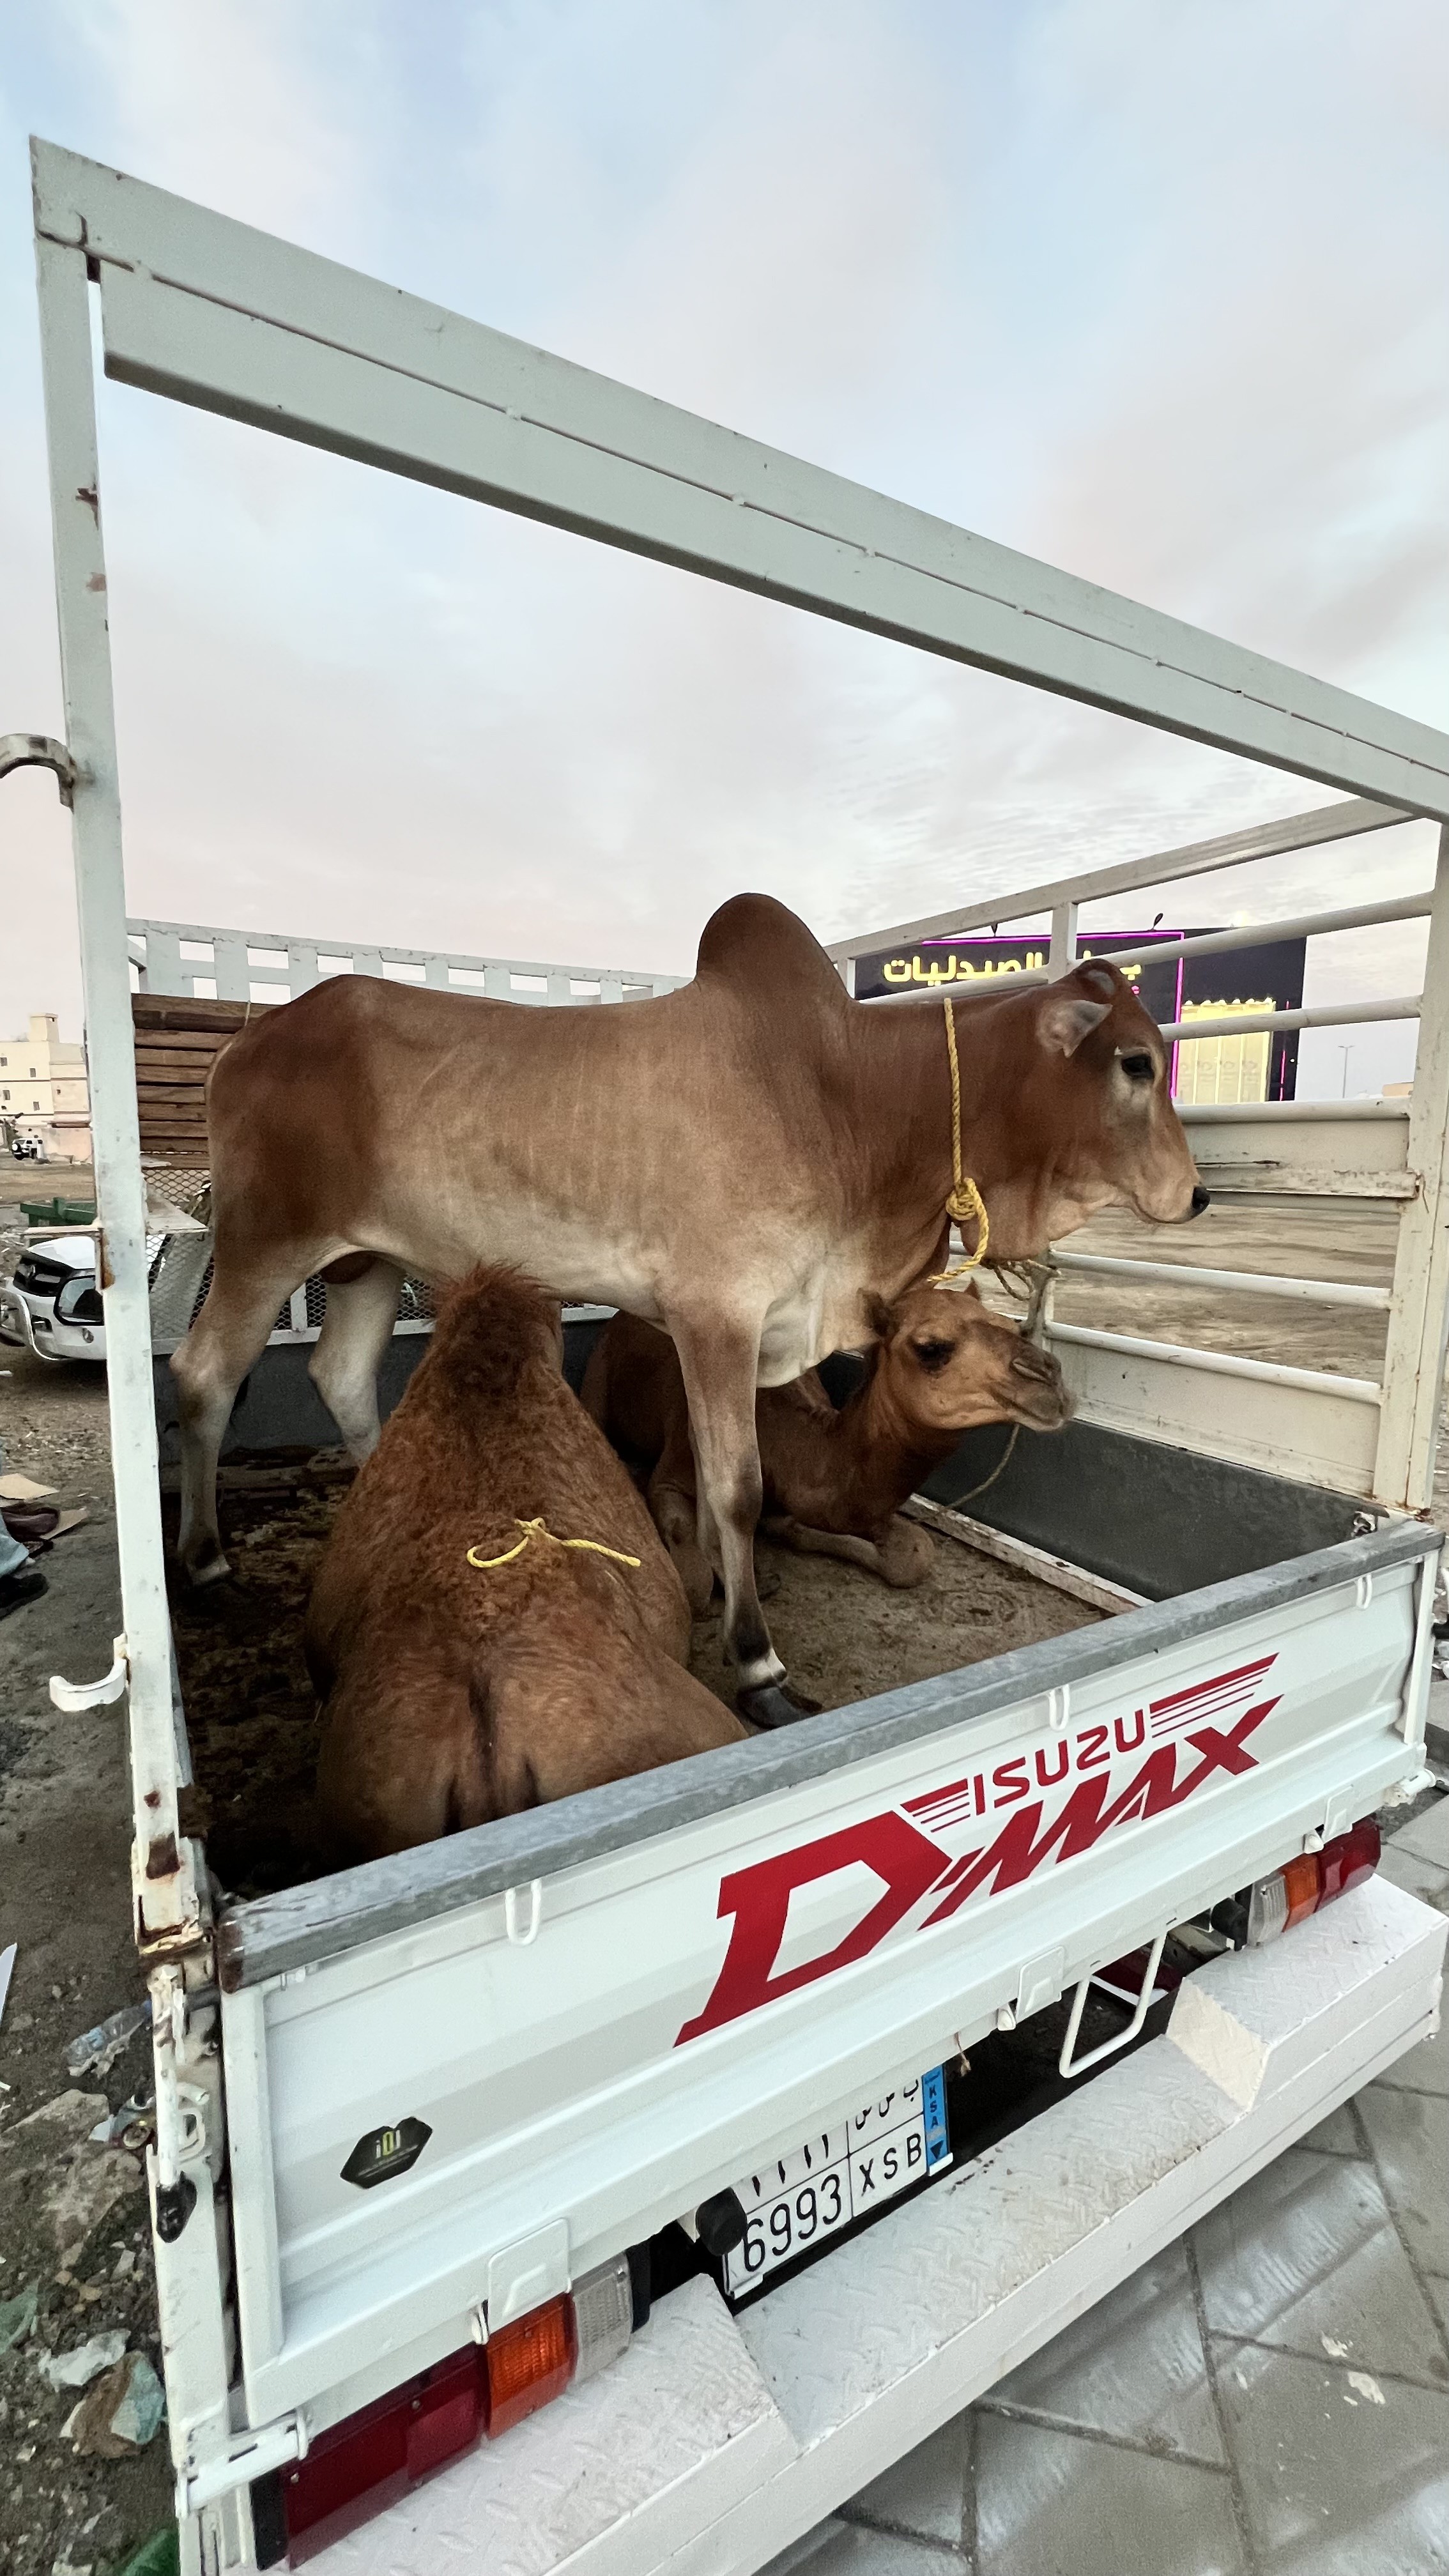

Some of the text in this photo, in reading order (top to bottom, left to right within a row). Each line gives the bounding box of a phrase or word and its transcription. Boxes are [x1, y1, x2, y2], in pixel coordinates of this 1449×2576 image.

[973, 1708, 1146, 1816] ISUZU
[929, 2084, 939, 2129] KSA
[742, 2173, 843, 2273] 6993
